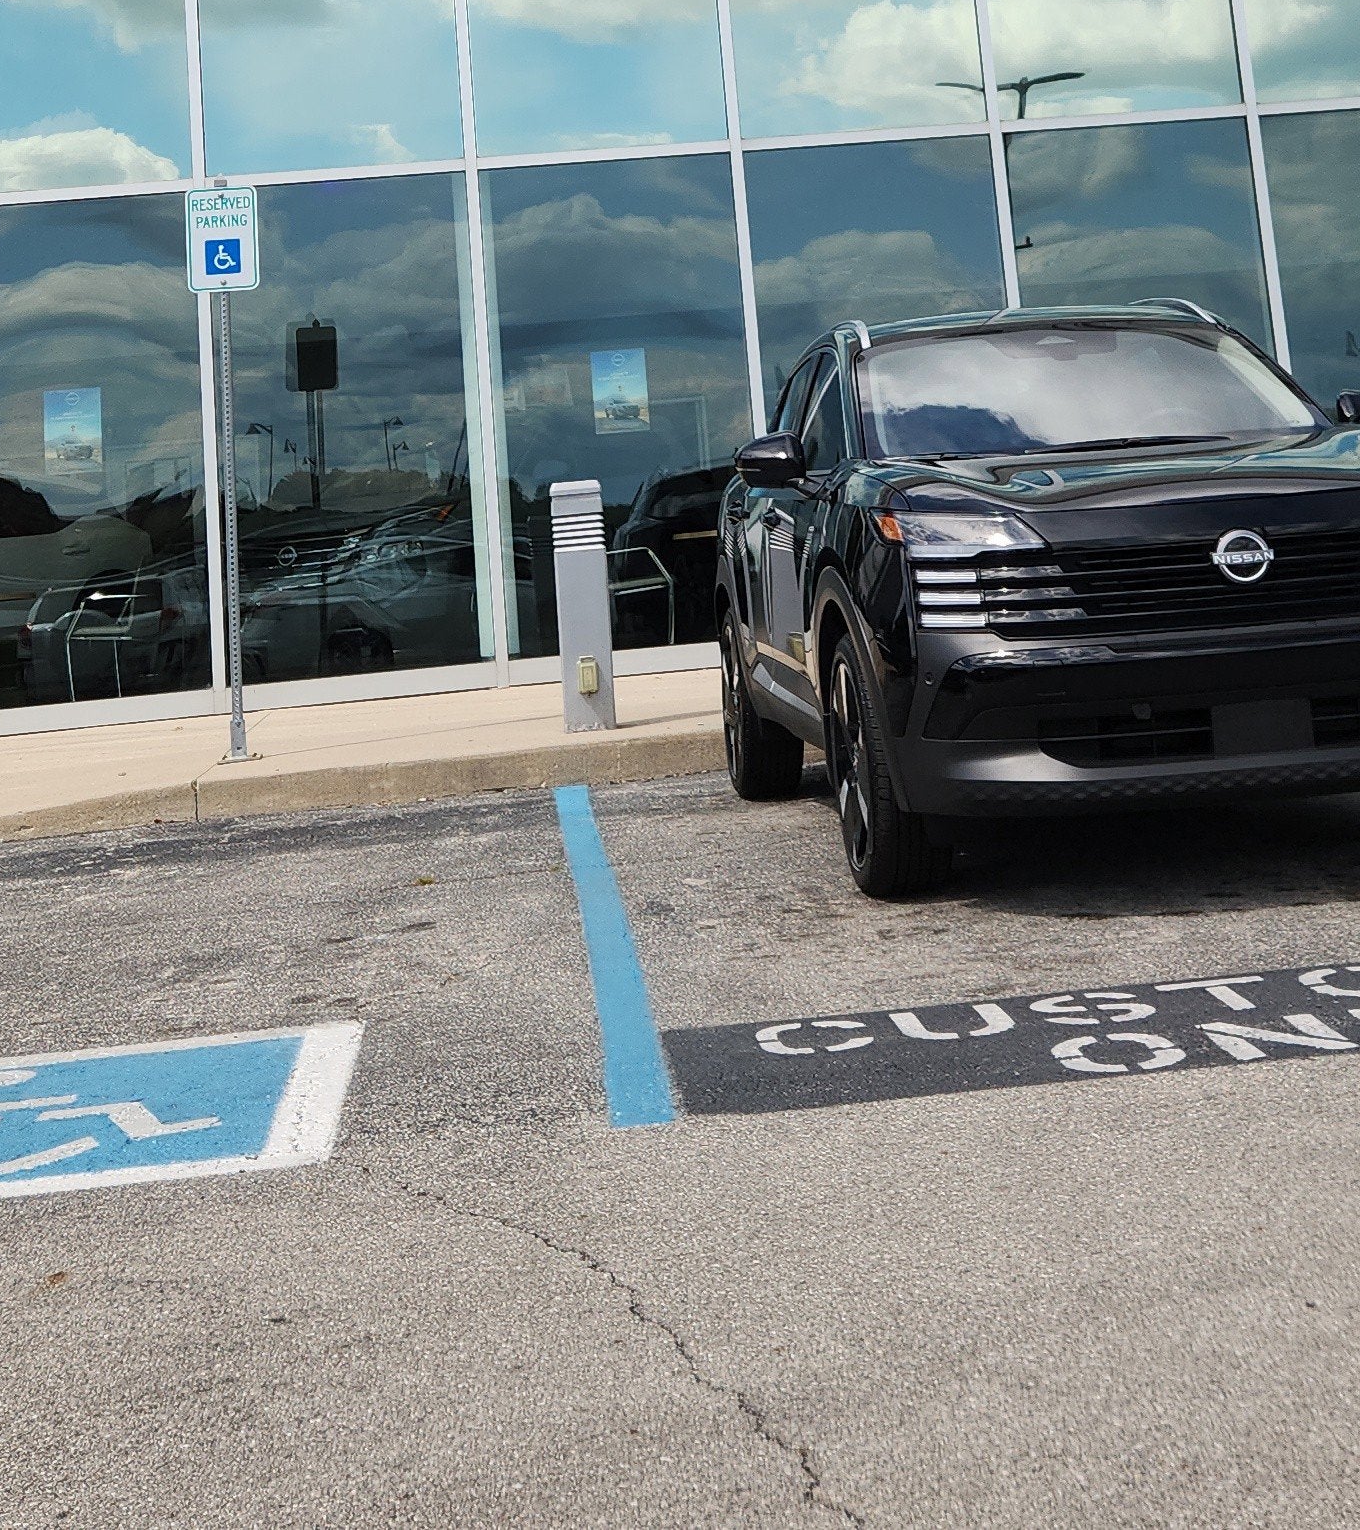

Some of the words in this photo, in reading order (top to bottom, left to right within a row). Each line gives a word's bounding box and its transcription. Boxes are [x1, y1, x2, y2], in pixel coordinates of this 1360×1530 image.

[191, 195, 251, 212] RESERVED
[196, 213, 248, 229] PARKING
[1211, 548, 1275, 566] NISSAN
